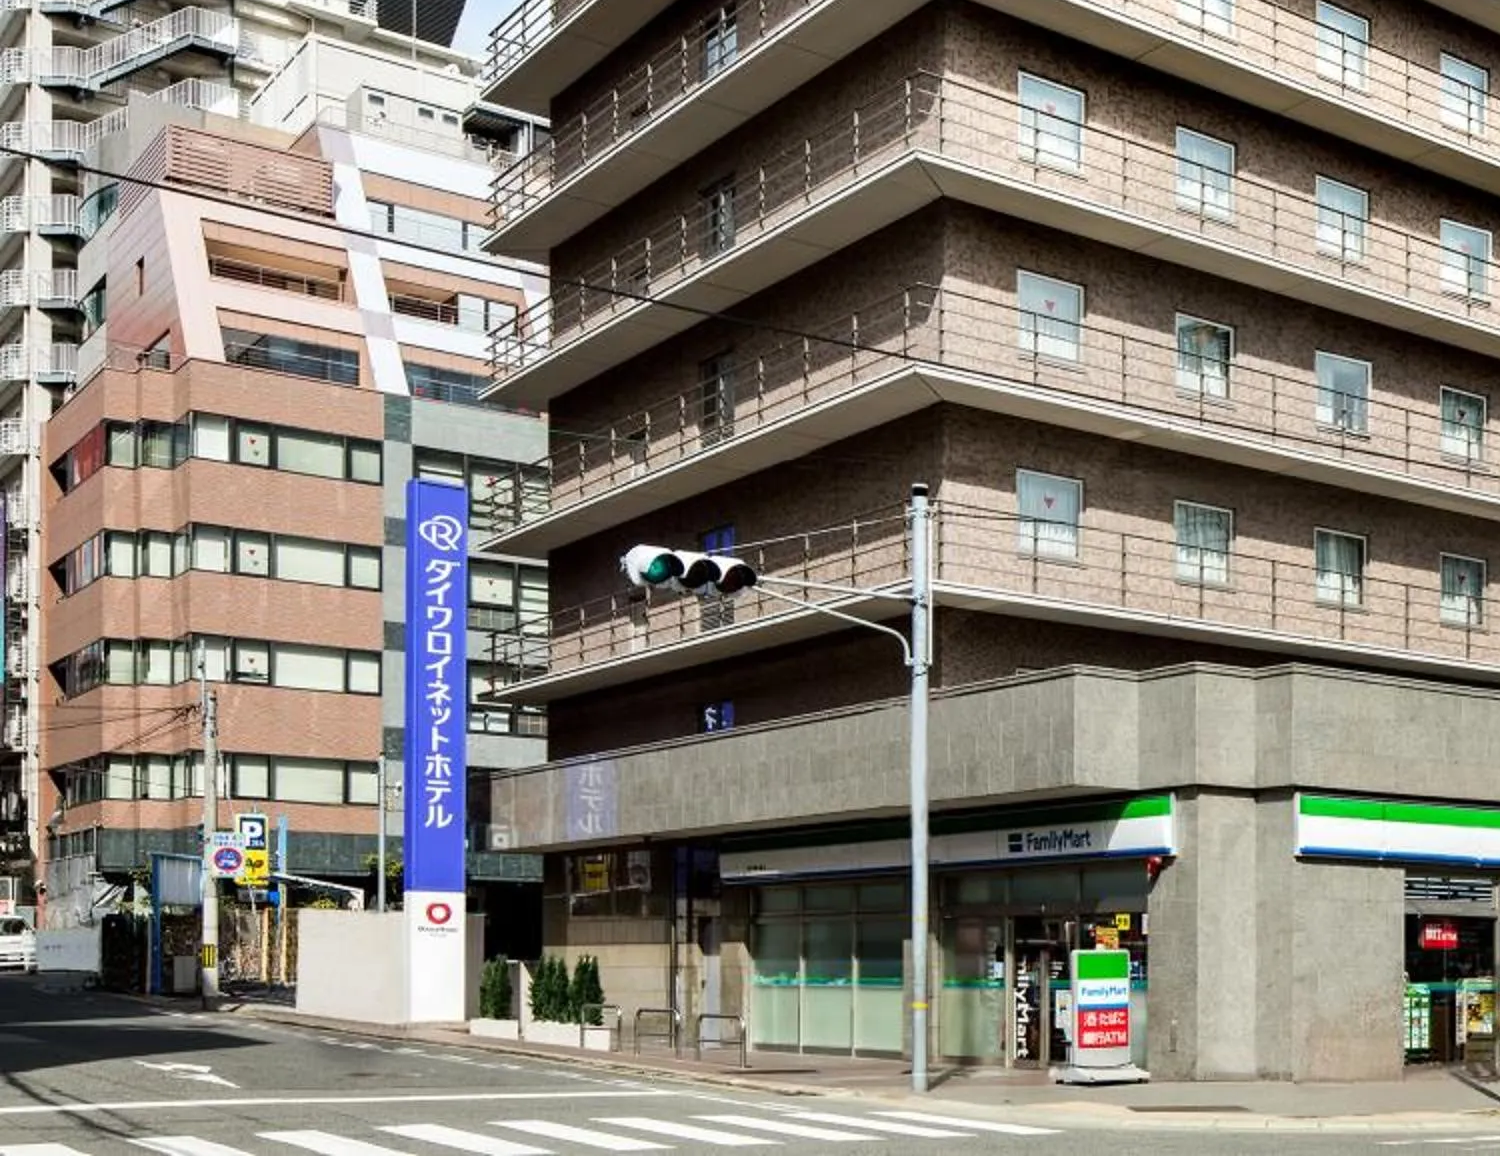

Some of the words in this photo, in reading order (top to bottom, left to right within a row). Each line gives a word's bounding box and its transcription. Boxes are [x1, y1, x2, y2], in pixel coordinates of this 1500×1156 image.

[425, 558, 460, 829] ダイワロイネットホテル
[241, 821, 262, 846] P
[1026, 828, 1091, 851] FamilyMart
[1081, 987, 1127, 999] FamilyMart
